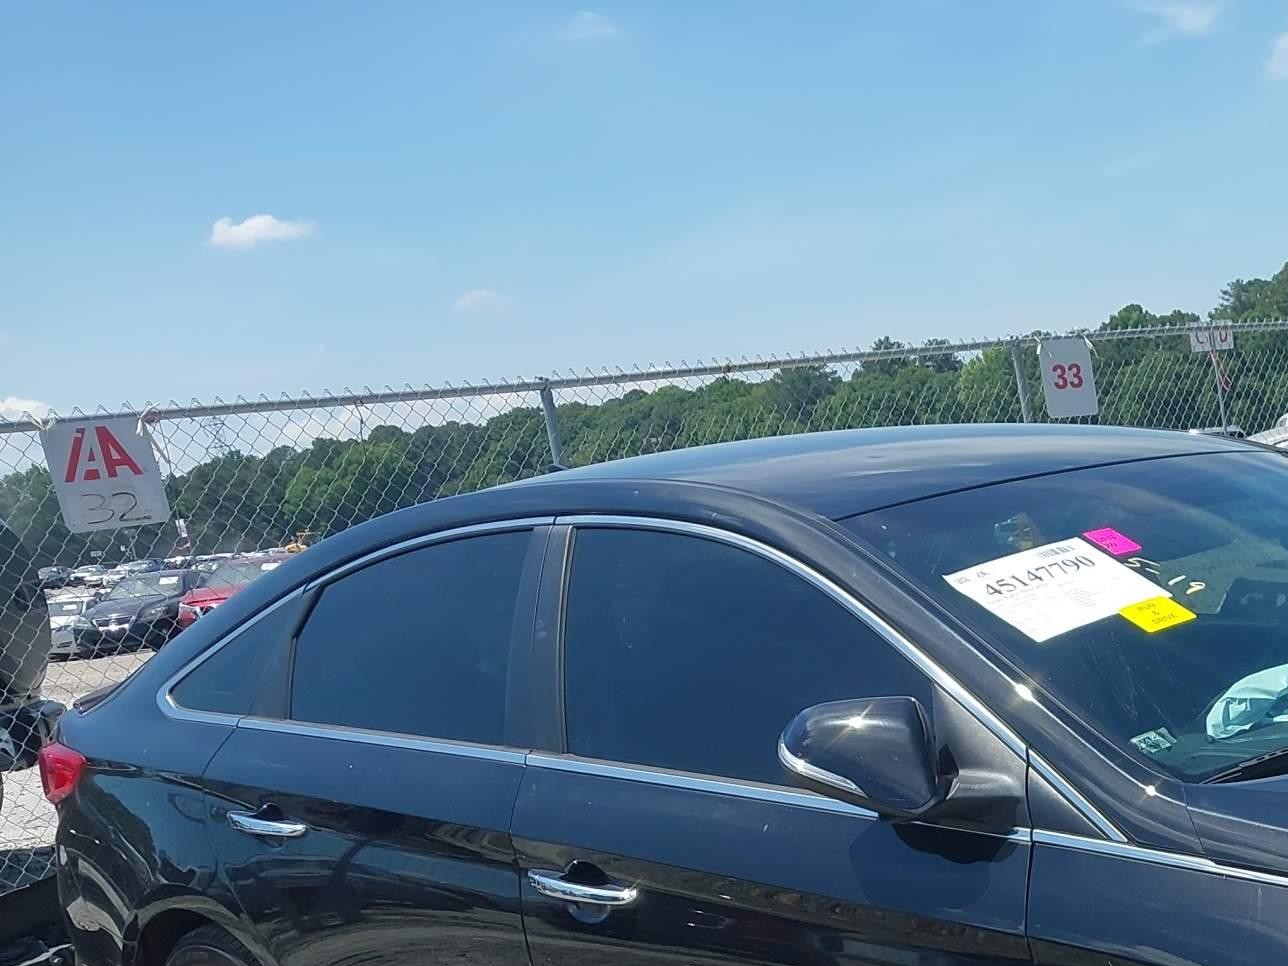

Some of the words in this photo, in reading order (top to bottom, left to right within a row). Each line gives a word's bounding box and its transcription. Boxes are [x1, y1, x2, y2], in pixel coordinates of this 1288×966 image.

[1052, 363, 1084, 390] 33
[65, 426, 144, 483] IAA
[81, 491, 152, 525] 32
[985, 555, 1096, 597] 45147790
